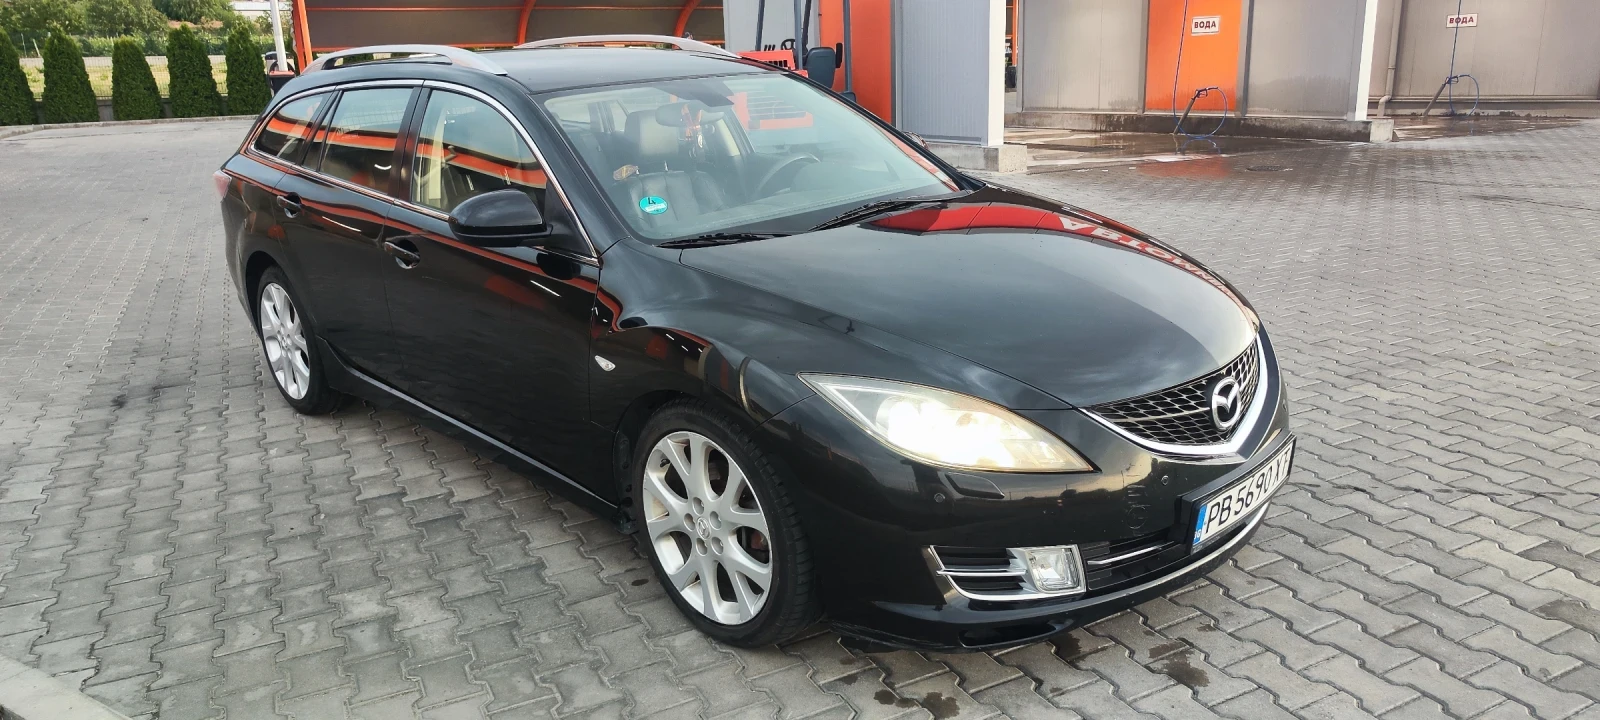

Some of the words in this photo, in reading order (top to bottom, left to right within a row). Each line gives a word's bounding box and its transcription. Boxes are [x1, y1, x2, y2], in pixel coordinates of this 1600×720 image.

[1449, 16, 1474, 25] ВОДА
[1194, 21, 1217, 30] ВОДА
[1205, 494, 1232, 534] PB
[1234, 465, 1273, 515] 5690
